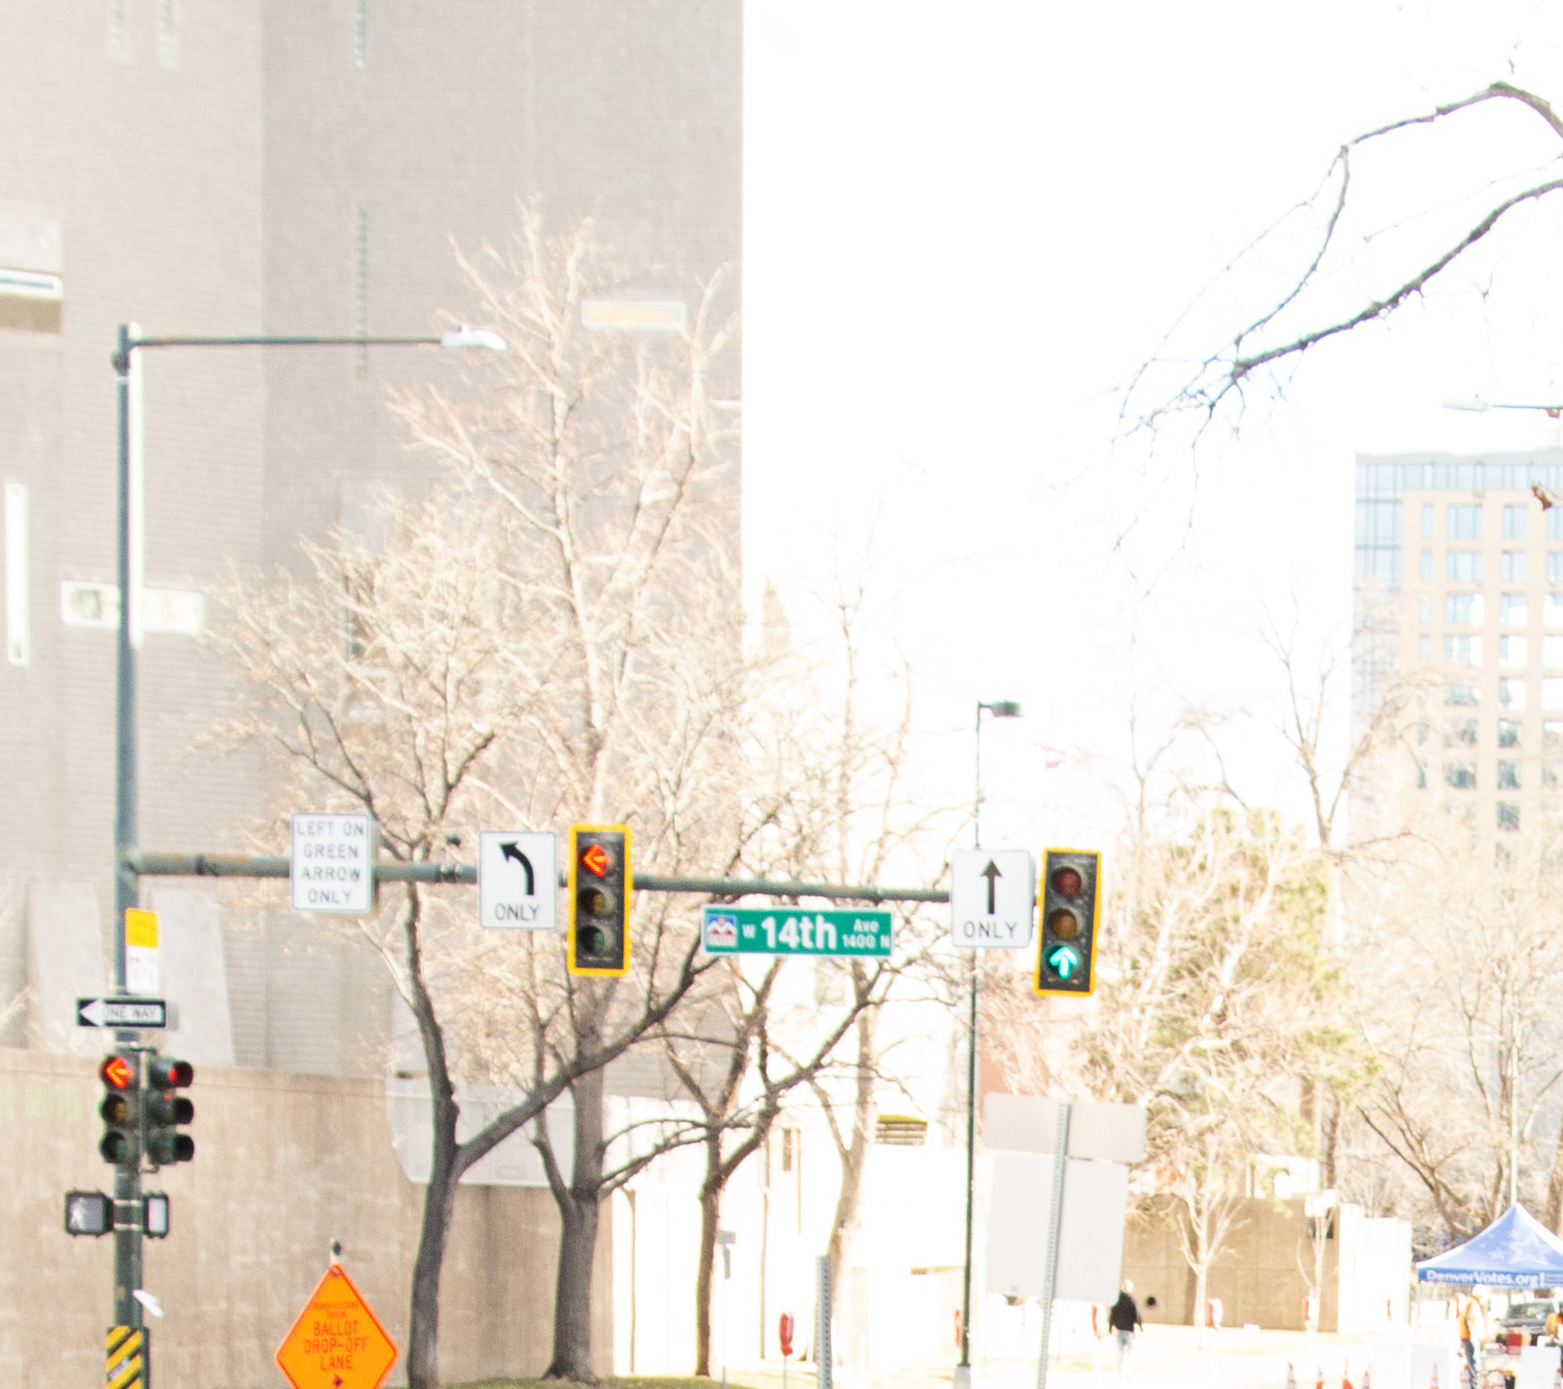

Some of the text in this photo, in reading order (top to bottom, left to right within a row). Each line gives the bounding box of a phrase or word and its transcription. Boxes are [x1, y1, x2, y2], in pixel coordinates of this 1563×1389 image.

[296, 819, 365, 838] LEFT ON
[302, 842, 359, 860] GREEN
[300, 866, 363, 884] ARROW
[307, 888, 354, 906] ONLY
[494, 902, 540, 922] ONLY
[760, 914, 837, 950] 14th
[853, 917, 880, 933] Ave
[963, 920, 1018, 941] ONLY
[842, 933, 876, 948] 1400
[102, 1005, 157, 1019] ONE WAY
[1425, 1269, 1538, 1288] DenverVotes.org
[313, 1320, 359, 1337] BALLOT
[304, 1336, 369, 1355] DROP-OFF
[319, 1354, 354, 1371] LANE
